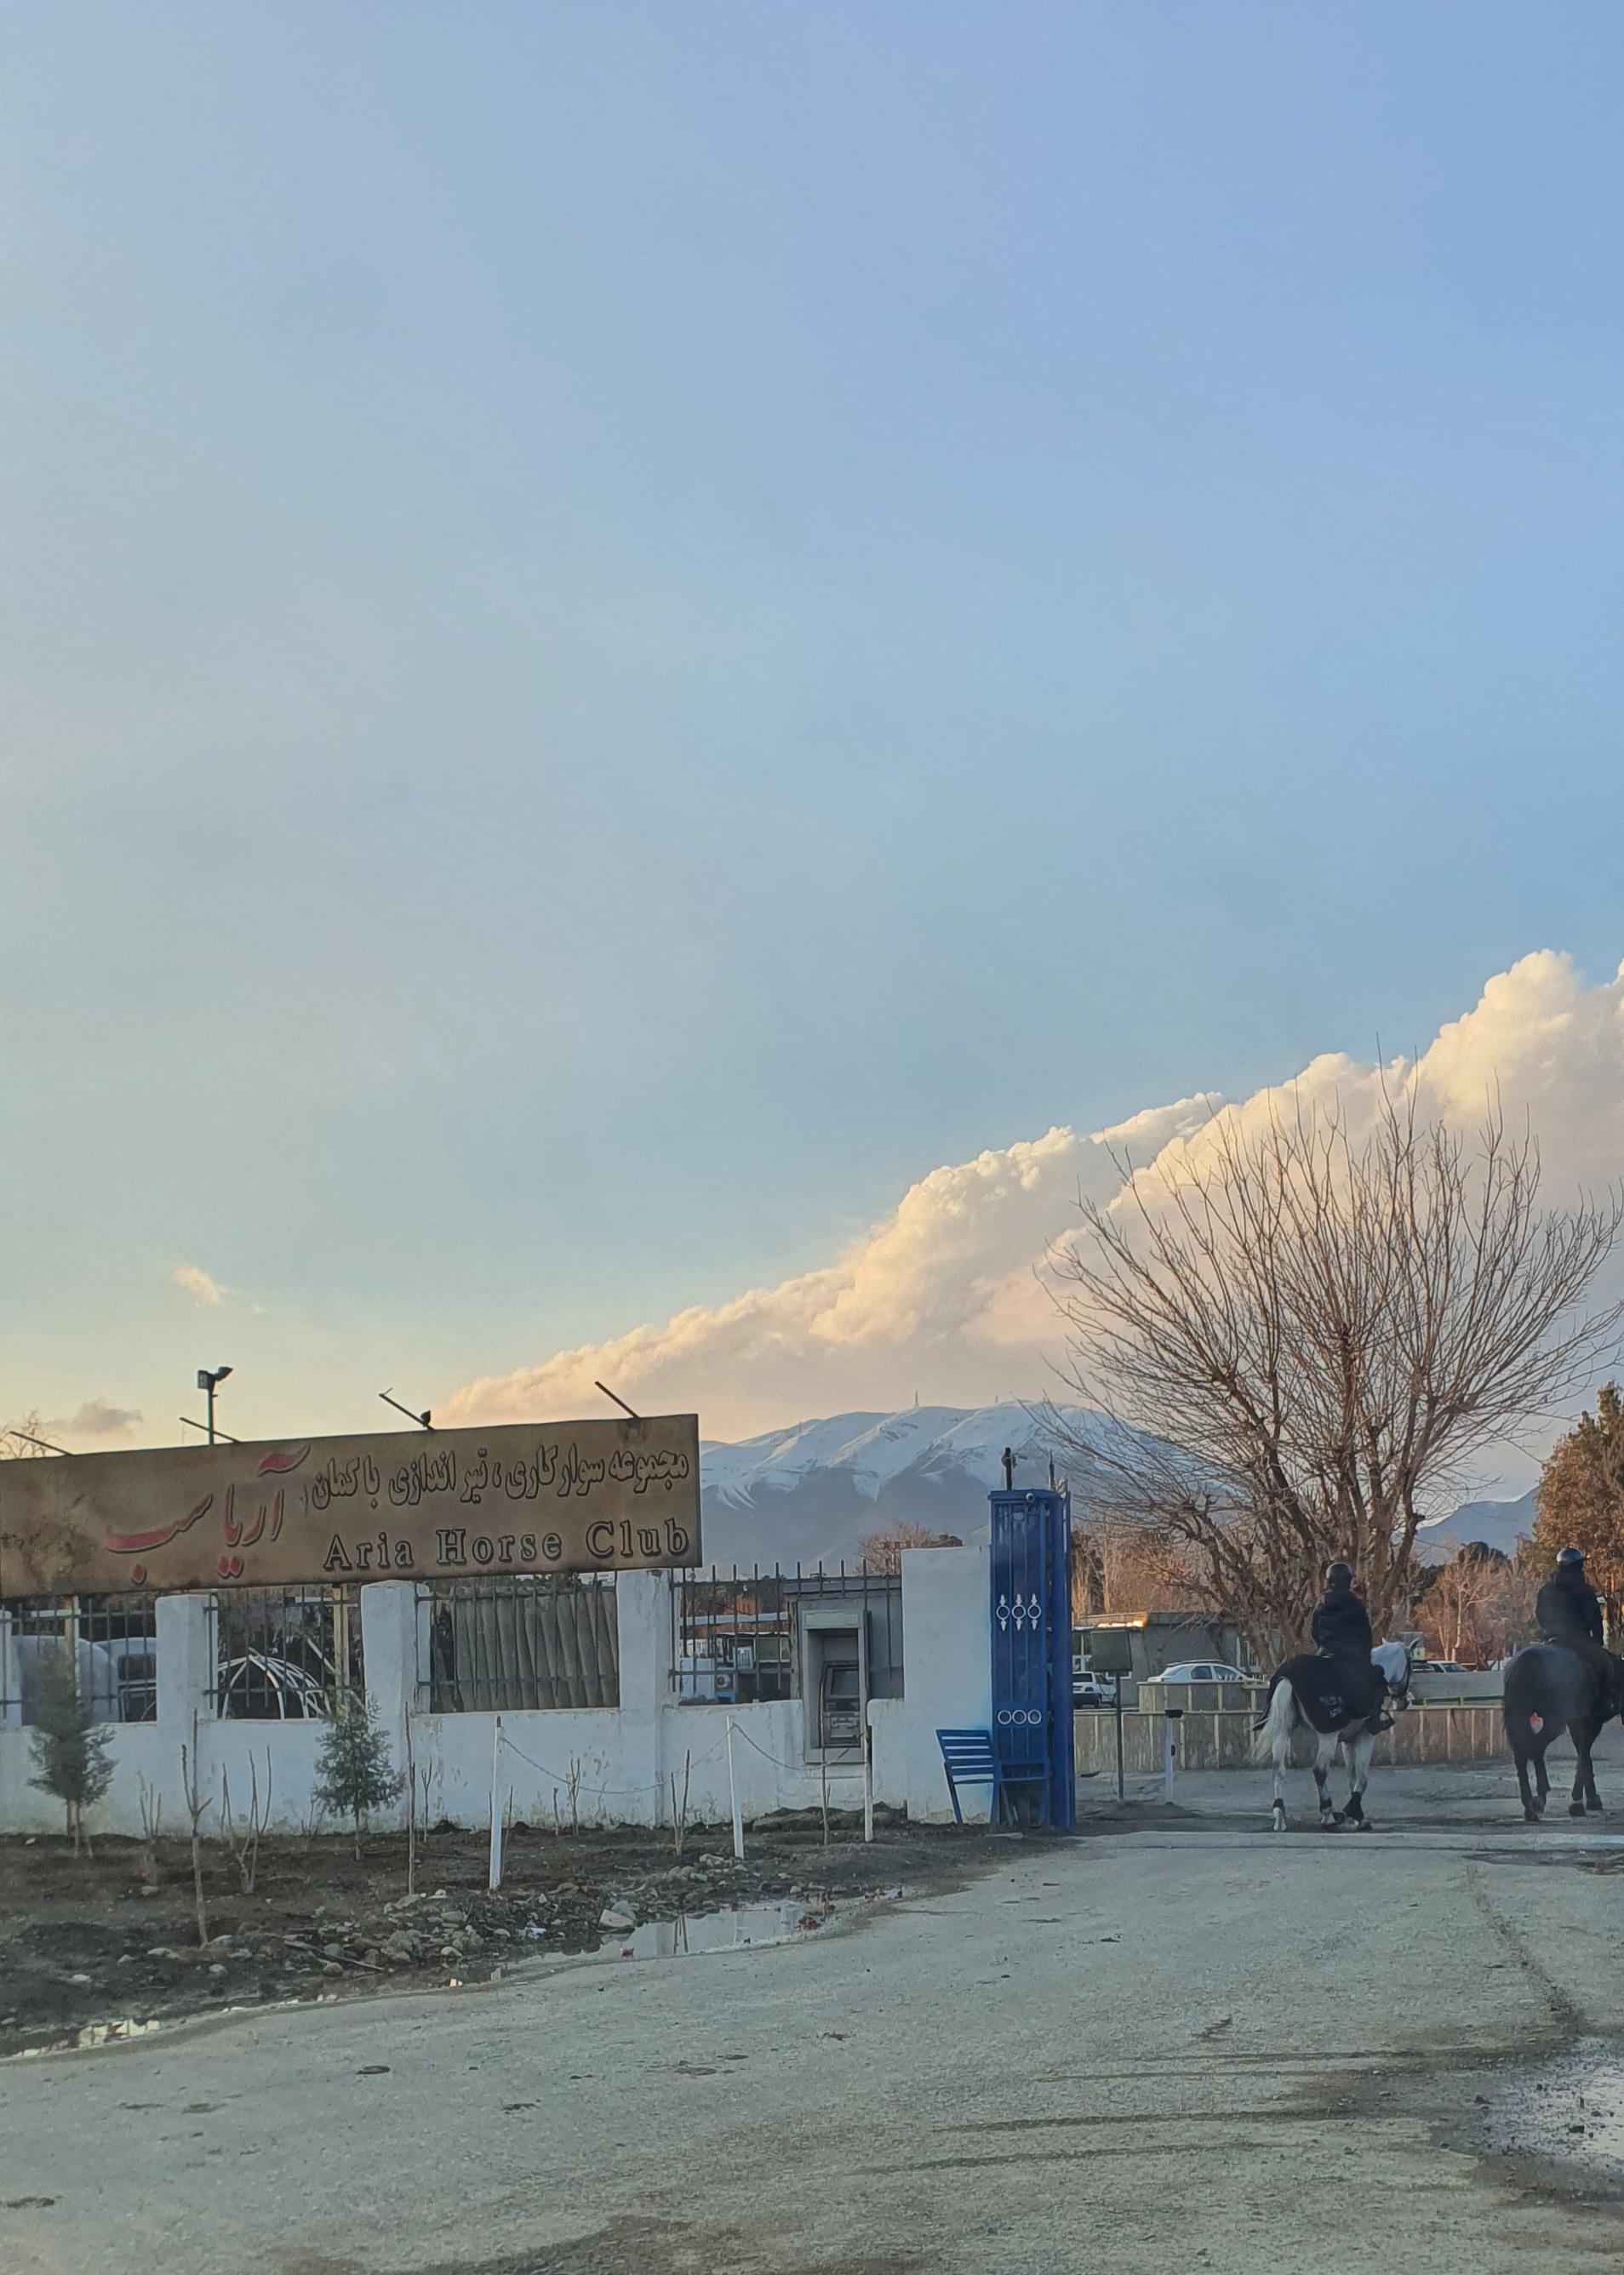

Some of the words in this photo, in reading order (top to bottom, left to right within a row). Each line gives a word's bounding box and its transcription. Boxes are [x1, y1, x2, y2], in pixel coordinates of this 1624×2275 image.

[609, 1449, 689, 1494] مجموعه
[323, 1531, 415, 1571] Aria
[435, 1529, 563, 1566] Horse
[585, 1518, 689, 1559] Club
